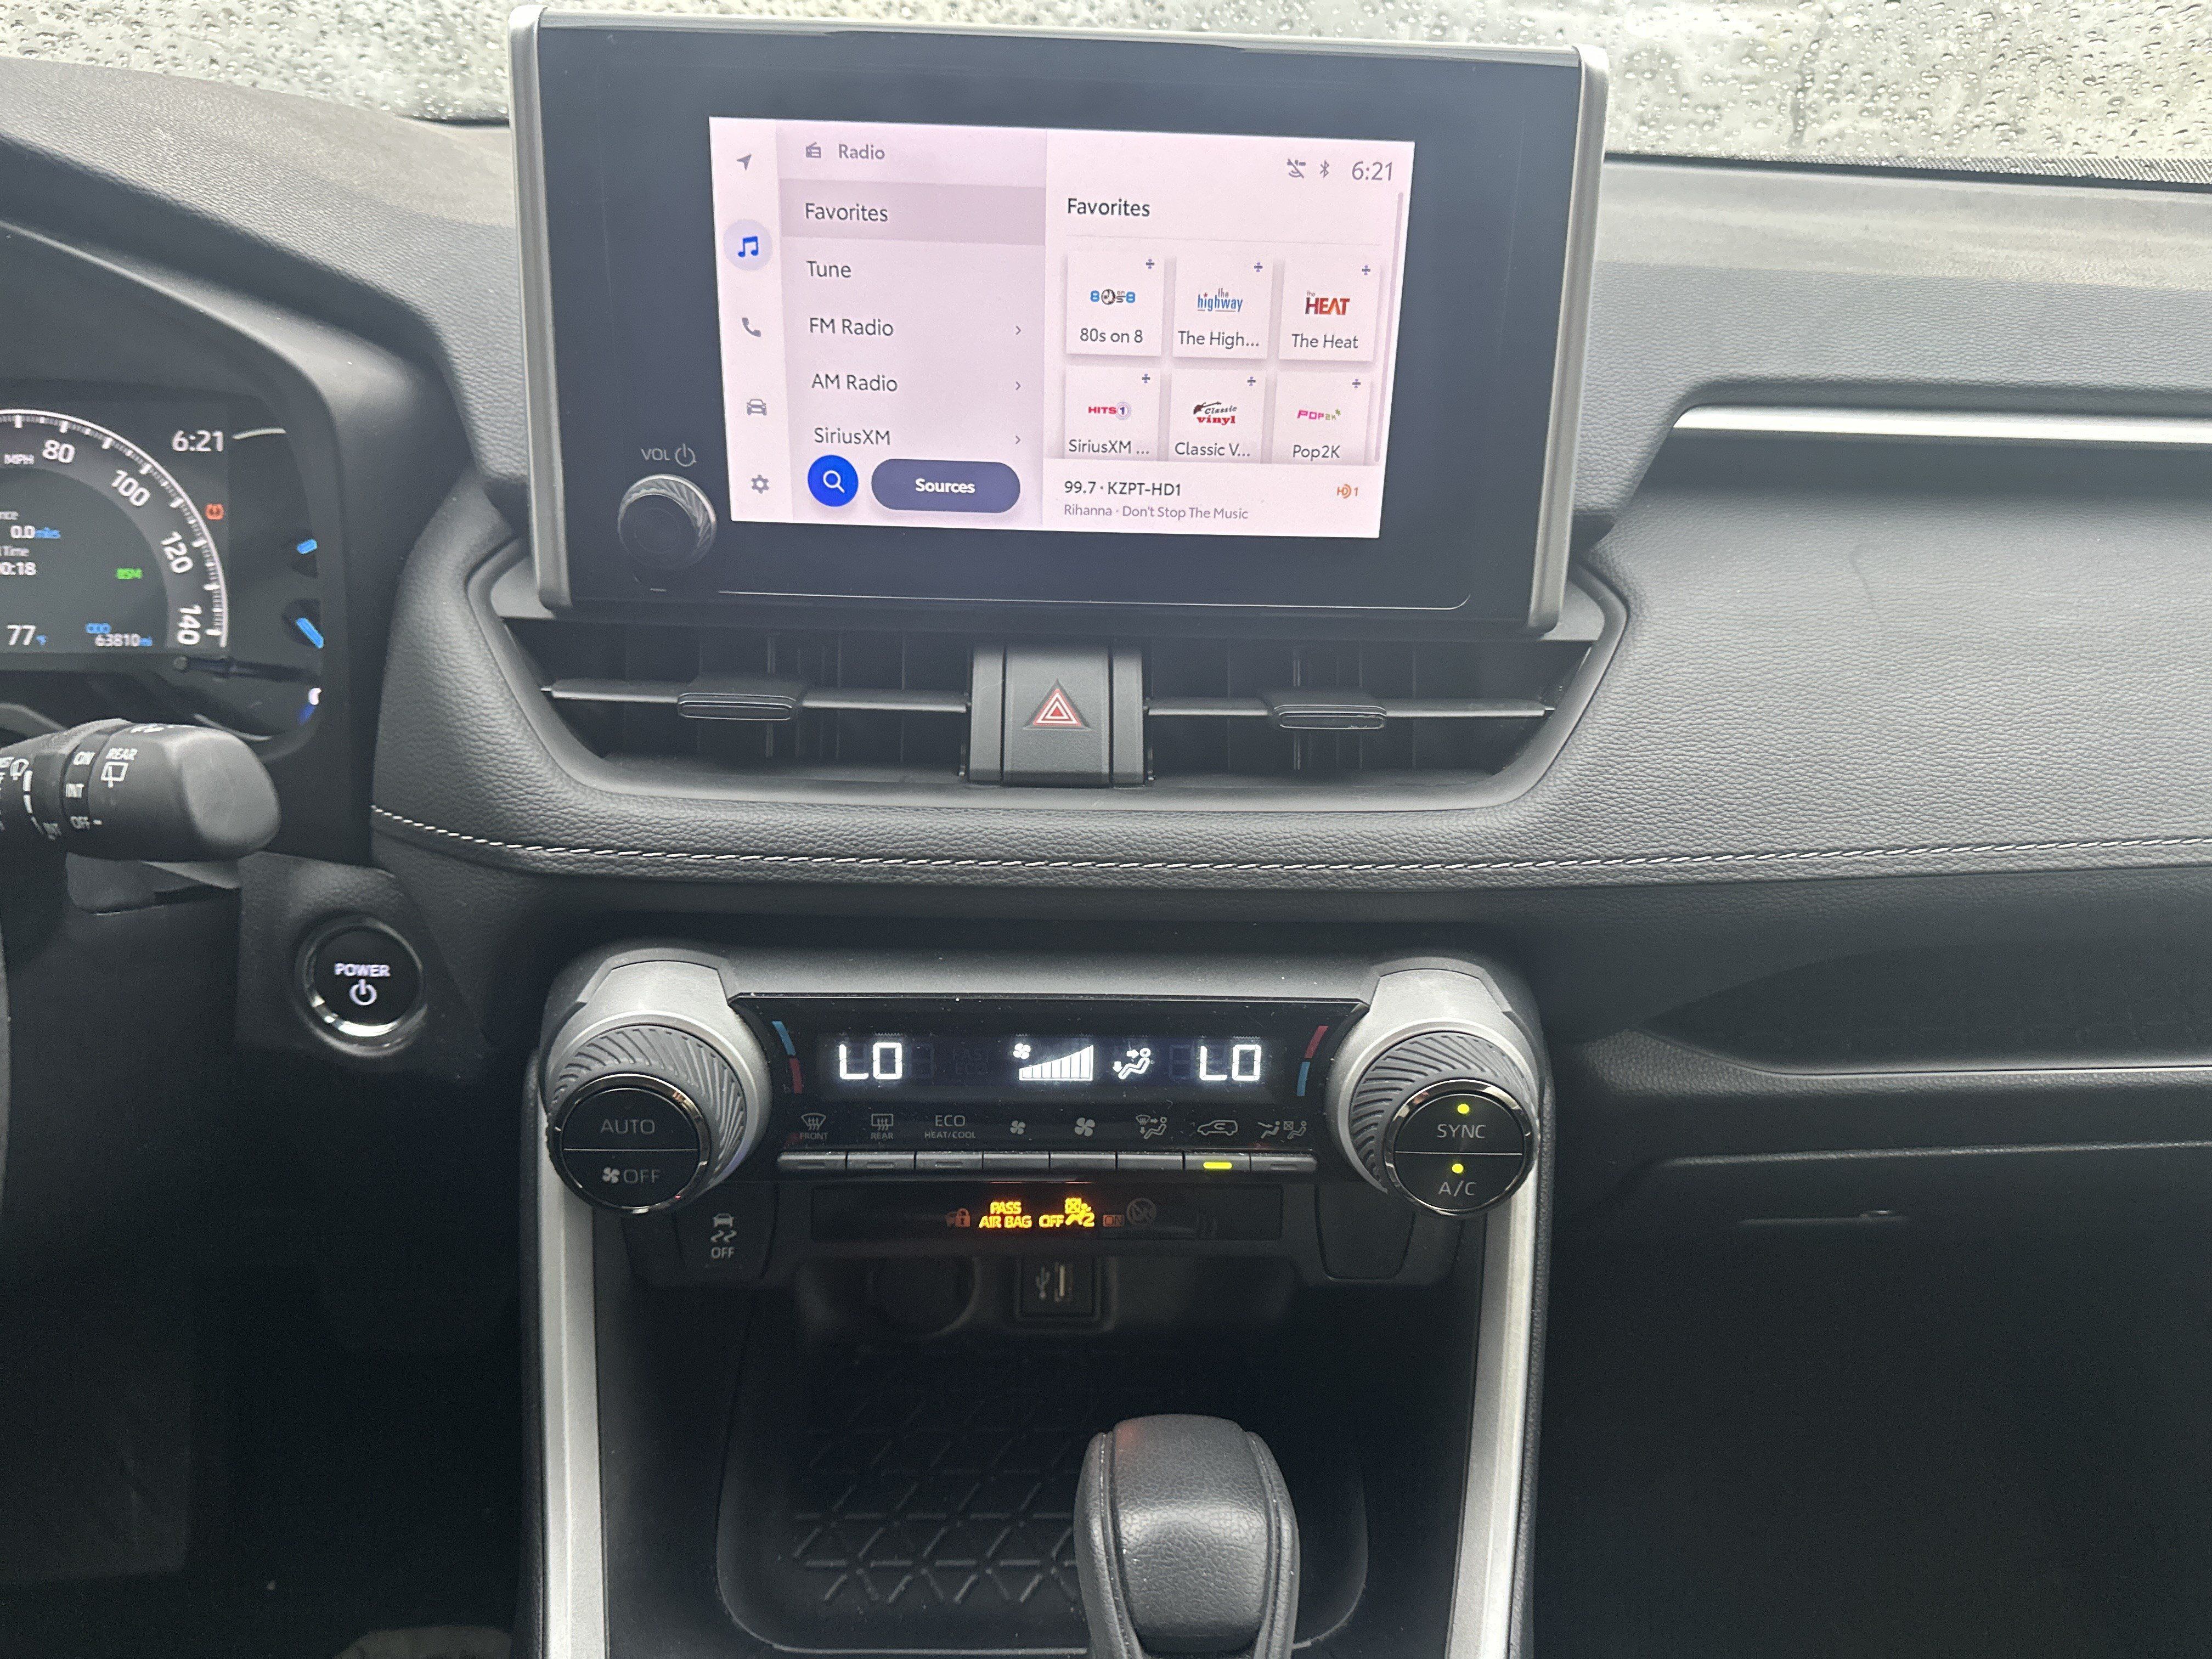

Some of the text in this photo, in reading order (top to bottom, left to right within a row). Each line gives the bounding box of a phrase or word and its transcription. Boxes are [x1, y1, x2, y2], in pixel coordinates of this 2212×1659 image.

[838, 144, 885, 160] Radio
[1352, 161, 1393, 182] 6:21
[805, 204, 888, 222] Favorites
[1067, 198, 1150, 217] Favorites
[807, 261, 851, 279] Tune
[1217, 287, 1229, 298] the
[1197, 294, 1243, 312] highway
[1305, 297, 1350, 315] HEAT
[810, 318, 894, 336] FM Radio
[1080, 328, 1143, 344] 80s on 8
[1178, 330, 1260, 349] The High...
[1291, 333, 1358, 348] The Heat
[811, 374, 898, 392] AM Radio
[1205, 405, 1237, 415] Classic
[1197, 415, 1235, 426] vinyl
[172, 431, 225, 453] 6:21
[814, 427, 890, 446] SiriusXM
[42, 439, 75, 463] 80
[641, 448, 671, 461] VOL
[1069, 439, 1132, 455] SiriusXM
[1175, 442, 1251, 458] Classic V...
[1293, 444, 1341, 462] Pop2K
[4, 454, 34, 465] MPH
[110, 469, 151, 507] 100
[916, 478, 975, 494] Sources
[1064, 481, 1182, 496] 99.7 KZPT-HD1
[1064, 504, 1249, 521] Rihanna Don't Stop The Music
[160, 531, 194, 574] 120
[0, 561, 37, 575] 0:18
[176, 604, 202, 645] 140
[7, 624, 36, 646] 77
[95, 633, 140, 647] 63810
[73, 752, 95, 765] ON
[105, 747, 138, 761] REAR
[334, 962, 391, 978] POWER
[839, 1042, 902, 1080] LO
[1200, 1045, 1261, 1081] LO
[601, 1120, 656, 1135] AUTO
[935, 1115, 966, 1127] ECO
[800, 1132, 828, 1141] FRONT
[871, 1132, 894, 1140] REAR
[924, 1131, 975, 1139] HEAT/COOL
[1437, 1124, 1487, 1139] SYNC
[623, 1169, 660, 1184] OFF
[1438, 1181, 1476, 1197] A/C
[990, 1201, 1022, 1214] PASS
[979, 1215, 1002, 1228] AIR
[1004, 1215, 1032, 1228] BAG
[1039, 1215, 1064, 1228] OFF
[711, 1248, 735, 1260] OFF
